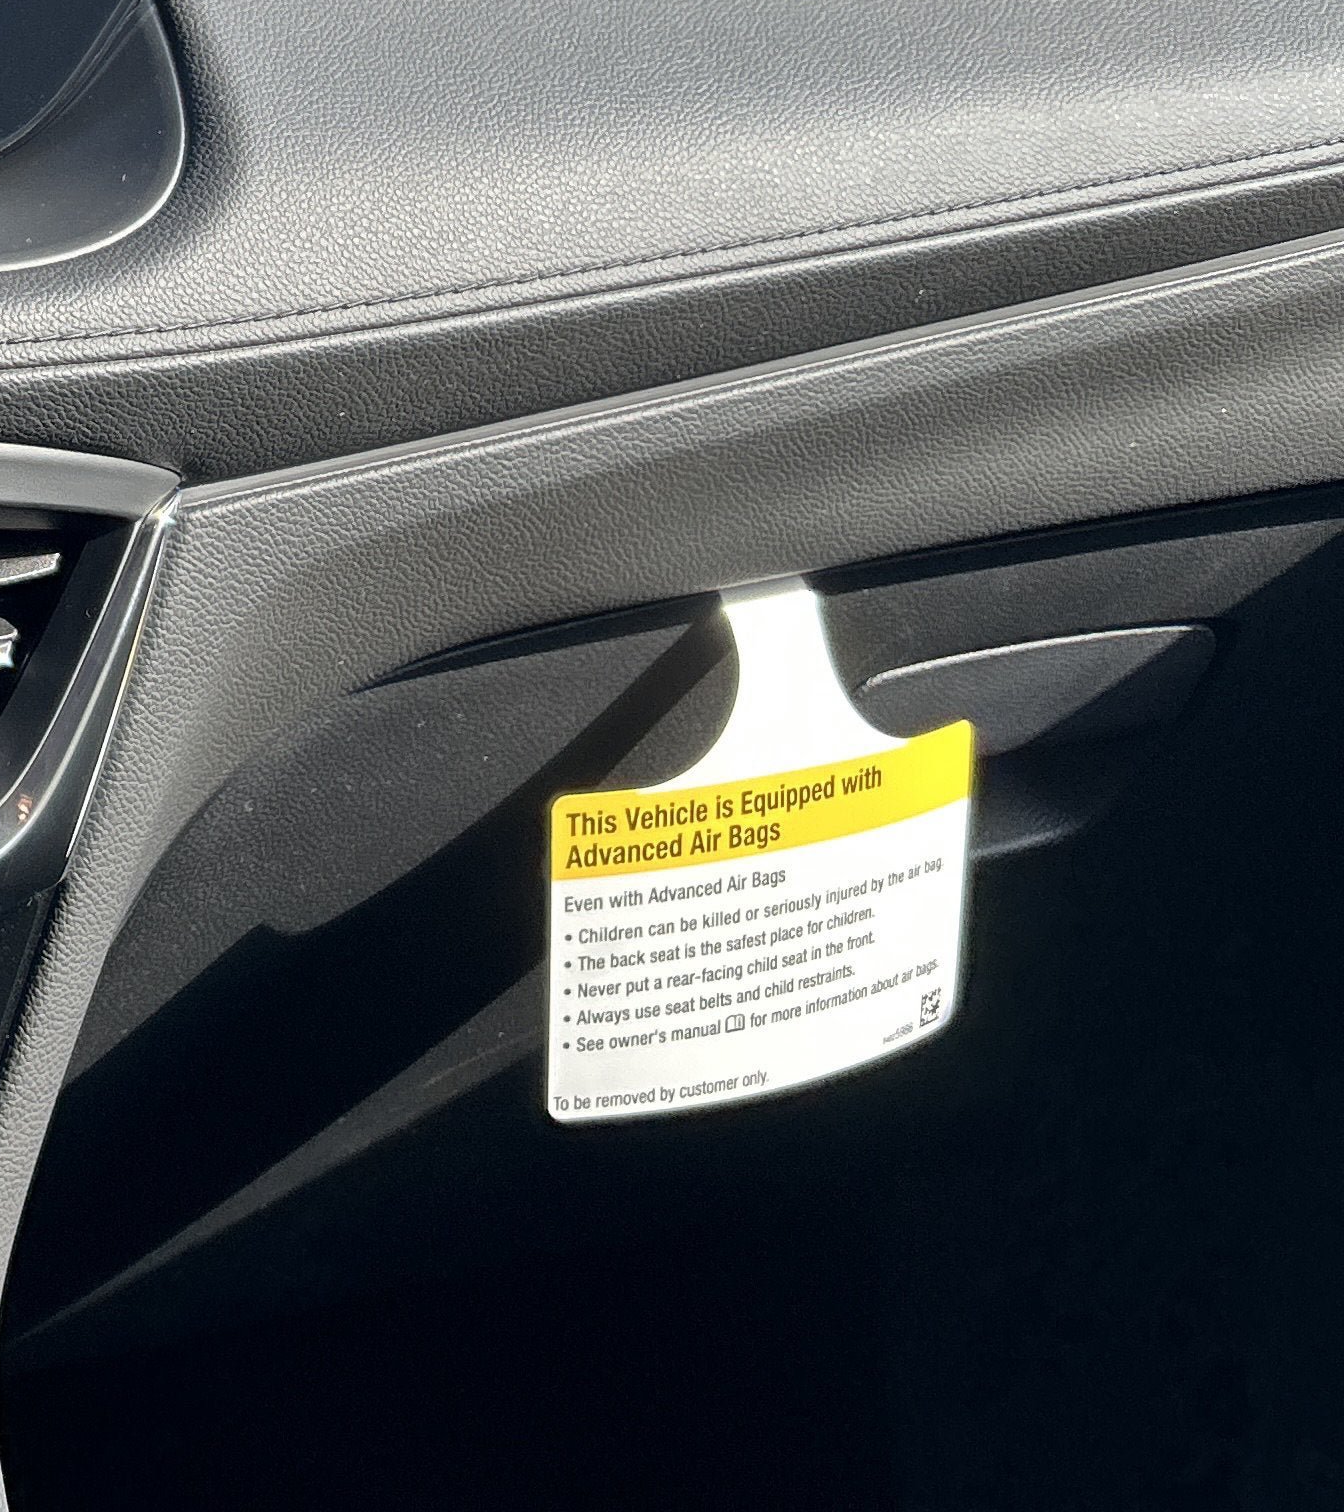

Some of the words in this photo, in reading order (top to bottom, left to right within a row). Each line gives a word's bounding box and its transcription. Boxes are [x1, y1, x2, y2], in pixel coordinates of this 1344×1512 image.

[565, 810, 617, 837] This
[625, 799, 708, 831] Vehicle
[715, 794, 734, 819] is
[740, 774, 835, 817] Equipped
[841, 765, 882, 796] with
[565, 833, 683, 869] Advanced
[689, 828, 722, 855] Air
[728, 822, 781, 850] Bags
[563, 895, 604, 913] Even
[609, 890, 644, 909] with
[647, 878, 723, 904] Advanced
[726, 873, 748, 893] Air
[751, 869, 786, 888] Bags
[578, 925, 643, 944] Children
[648, 921, 675, 937] can
[680, 917, 698, 933] be
[702, 908, 741, 930] killed
[745, 908, 760, 921] or
[763, 892, 822, 919] seriously
[825, 880, 867, 905] injured
[870, 877, 884, 894] by
[887, 870, 905, 888] the
[907, 864, 921, 880] air
[577, 955, 605, 972] The
[610, 950, 646, 968] back
[650, 945, 681, 964] seat
[684, 942, 696, 959] is
[700, 940, 722, 956] the
[726, 930, 767, 953] safest
[769, 925, 804, 947] place
[807, 918, 823, 935] for
[826, 906, 876, 931] children.
[577, 982, 622, 999] Never
[625, 976, 650, 997] put
[653, 977, 663, 990] a
[666, 964, 744, 989] rear-facing
[746, 955, 778, 976] child
[781, 949, 808, 968] seat
[811, 945, 822, 961] in
[825, 941, 844, 957] the
[847, 931, 876, 951] front.
[576, 1007, 631, 1026] Always
[634, 1004, 661, 1020] use
[664, 997, 696, 1016] seat
[698, 992, 732, 1011] belts
[736, 985, 761, 1004] and
[764, 978, 794, 998] child
[797, 964, 856, 990] restraints.
[576, 1036, 604, 1053] See
[608, 1029, 667, 1050] owner's
[670, 1019, 721, 1042] manual
[750, 1012, 768, 1028] for
[771, 1005, 802, 1023] more
[805, 986, 868, 1015] information
[870, 973, 899, 996] about
[901, 968, 914, 983] air
[553, 1096, 570, 1112] To
[573, 1094, 591, 1110] be
[595, 1088, 656, 1108] removed
[659, 1086, 676, 1103] by
[679, 1076, 739, 1098] customer
[742, 1069, 770, 1087] only.
